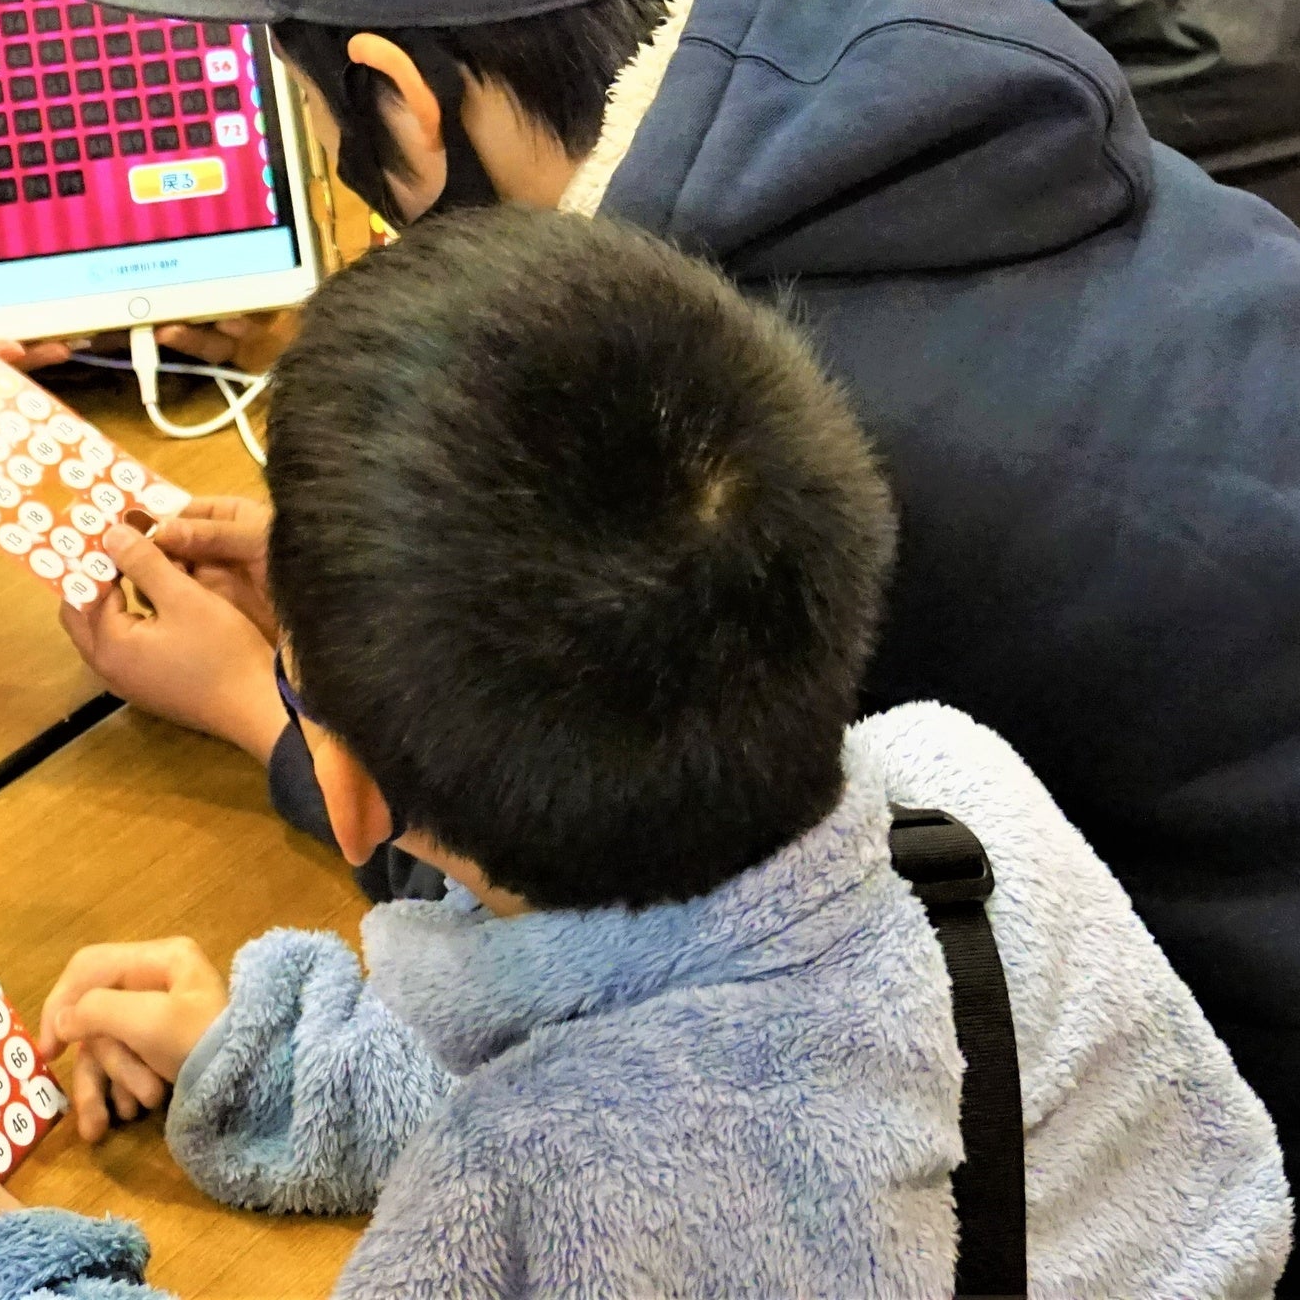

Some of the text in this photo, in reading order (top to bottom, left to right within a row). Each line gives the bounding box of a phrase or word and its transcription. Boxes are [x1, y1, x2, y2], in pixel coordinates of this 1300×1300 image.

[211, 60, 232, 74] 56
[223, 124, 242, 137] 72
[161, 173, 194, 192] 戻る
[57, 422, 73, 435] 73
[37, 442, 53, 457] 48
[89, 446, 104, 460] 71
[17, 463, 33, 478] 38
[69, 467, 85, 481] 46
[119, 469, 136, 484] 62
[100, 491, 116, 506] 53
[27, 510, 44, 523] 18
[80, 512, 97, 527] 45
[6, 533, 22, 546] 13
[59, 535, 74, 550] 21
[40, 559, 52, 568] 1
[93, 559, 108, 575] 23
[72, 582, 87, 595] 10
[11, 1047, 27, 1068] 66
[36, 1087, 51, 1106] 71
[13, 1113, 27, 1132] 46
